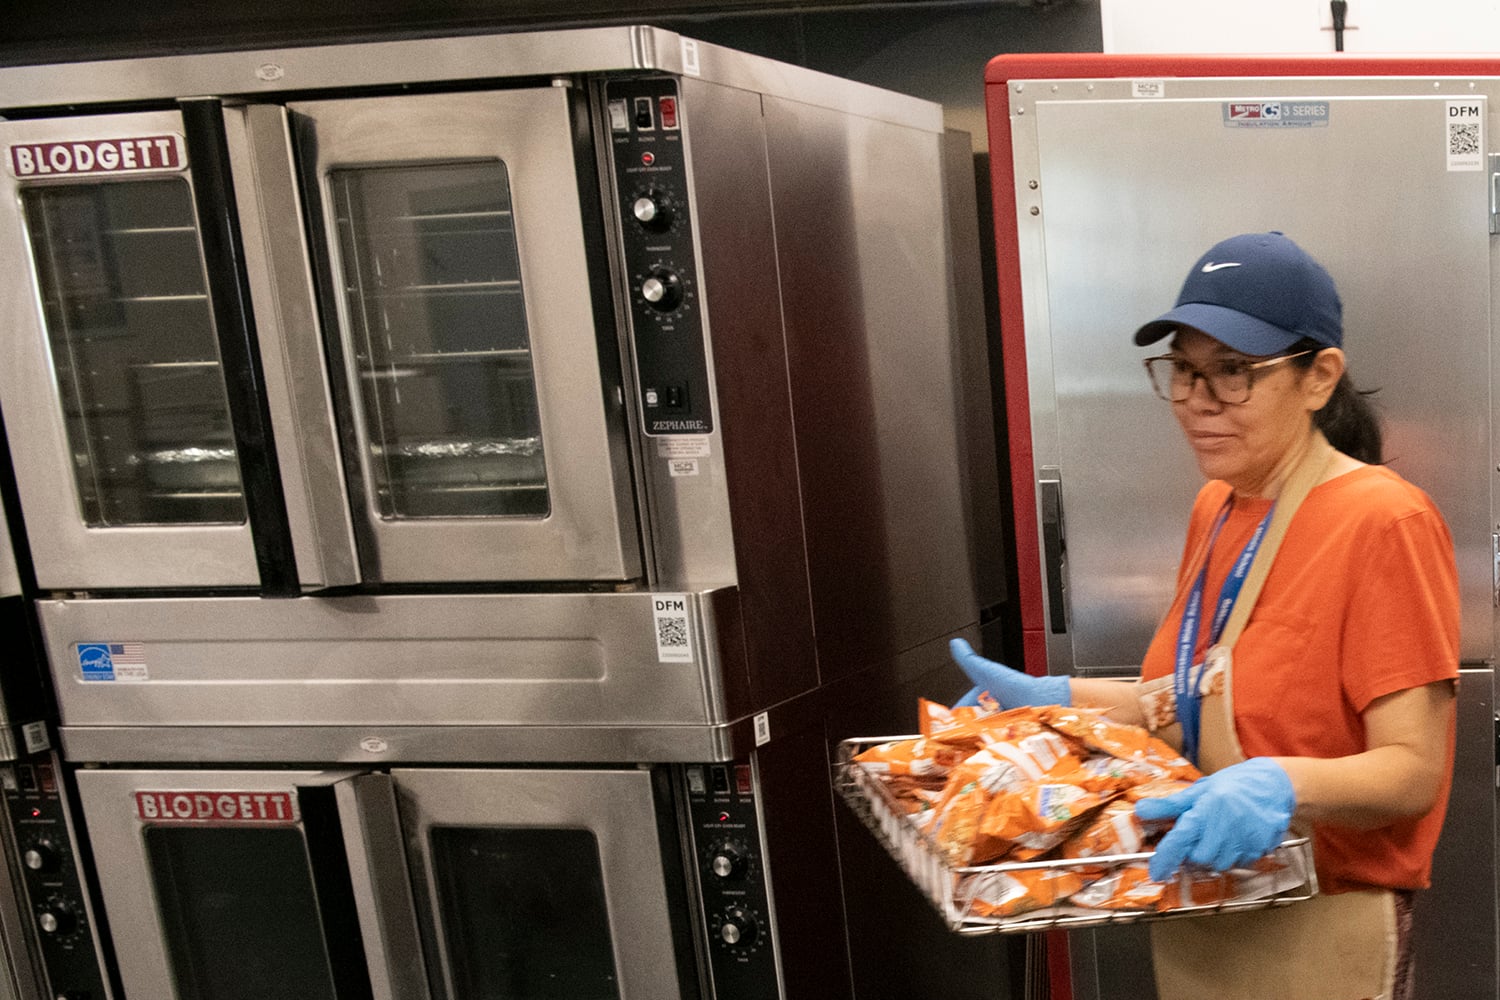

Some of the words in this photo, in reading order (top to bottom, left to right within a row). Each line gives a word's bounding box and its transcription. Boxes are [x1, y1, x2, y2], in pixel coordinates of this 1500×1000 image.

[1283, 105, 1290, 117] 3
[1292, 105, 1326, 117] SERIES
[1449, 106, 1479, 117] DFM
[16, 139, 170, 175] BLODGETT
[653, 421, 704, 431] ZEPHAIRE
[655, 600, 684, 612] DFM
[141, 795, 285, 819] BLODGETT
